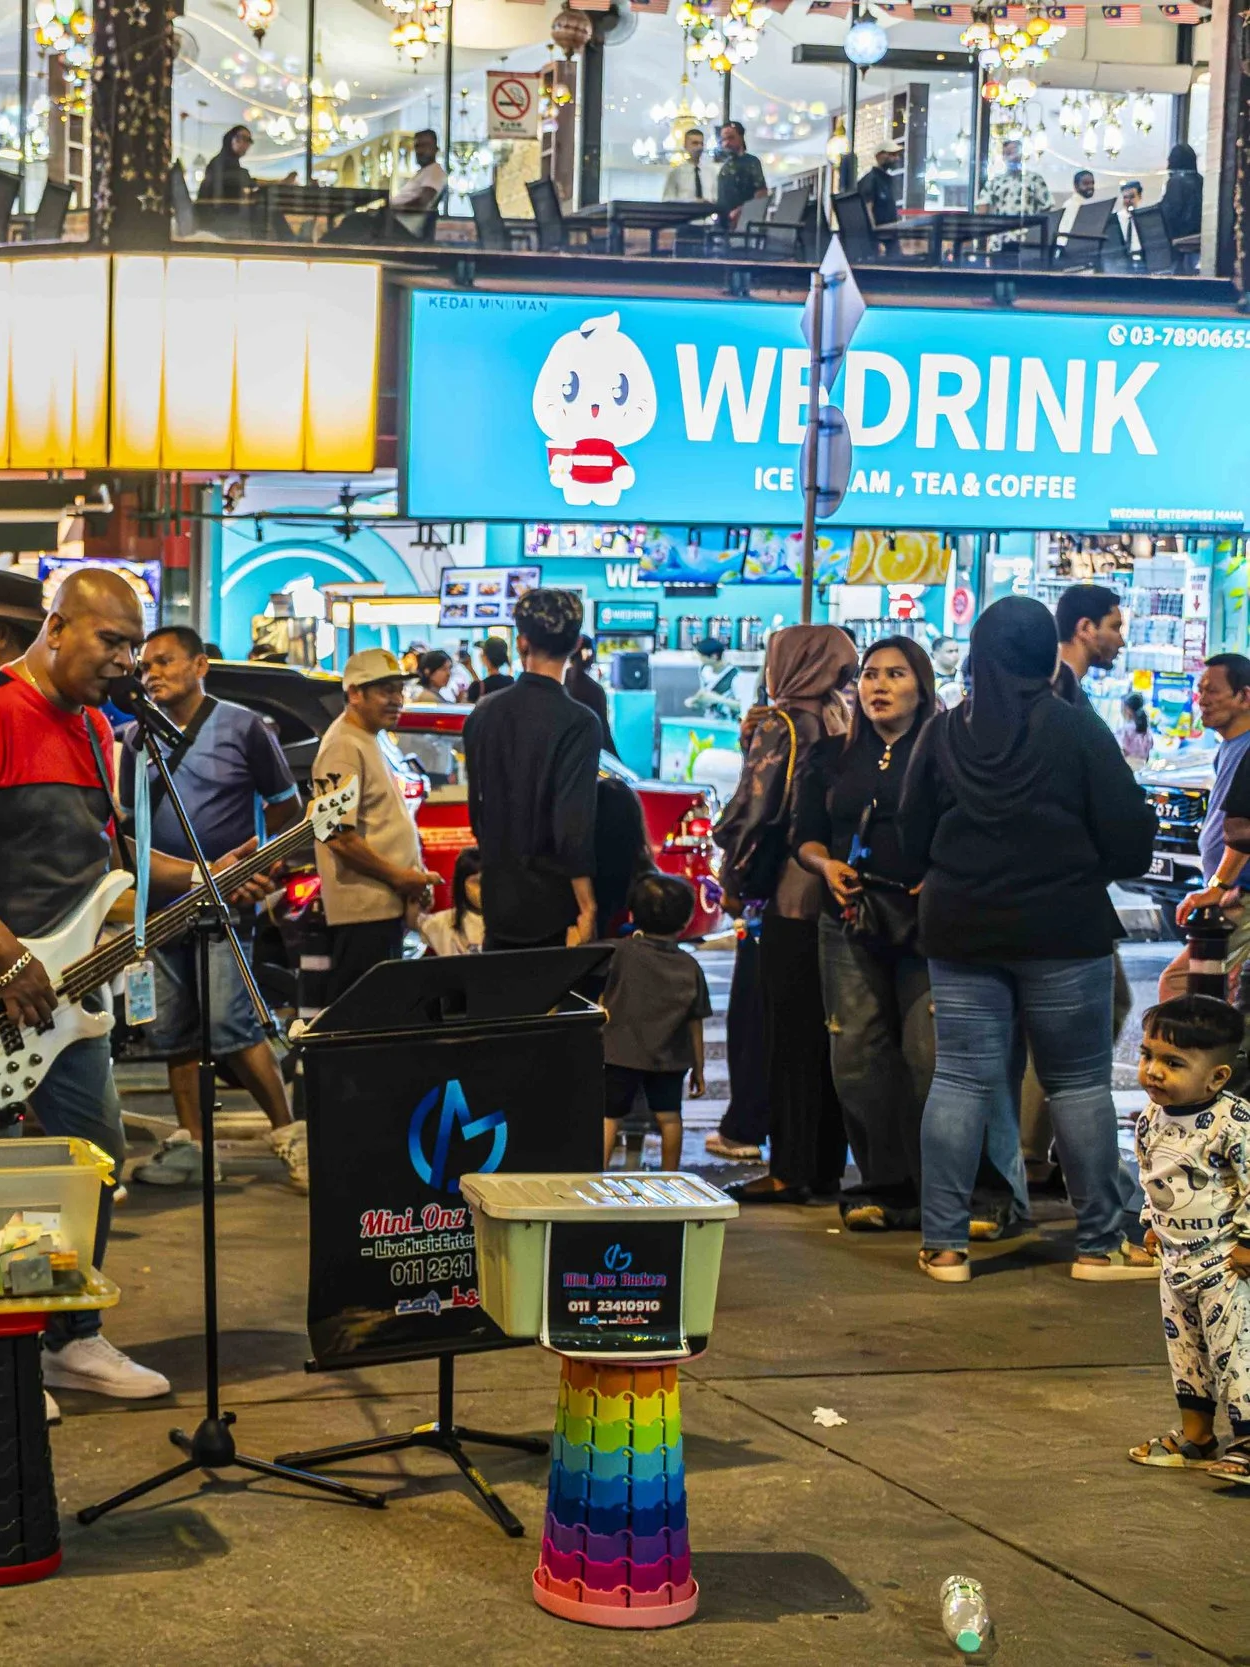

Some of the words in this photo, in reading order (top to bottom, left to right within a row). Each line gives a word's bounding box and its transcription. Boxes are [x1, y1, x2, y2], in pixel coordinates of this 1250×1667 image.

[429, 296, 473, 309] KEDAI
[479, 298, 548, 312] MINUMAN
[675, 344, 1161, 456] WEDRINK
[754, 467, 795, 492] ICE
[911, 471, 957, 496] TEA
[961, 472, 980, 496] &
[985, 474, 1077, 499] COFFEE
[360, 1203, 466, 1238] Mini_Onz
[390, 1259, 424, 1285] 011
[427, 1253, 472, 1282] 2341
[568, 1300, 590, 1312] 011
[597, 1300, 661, 1312] 23410910
